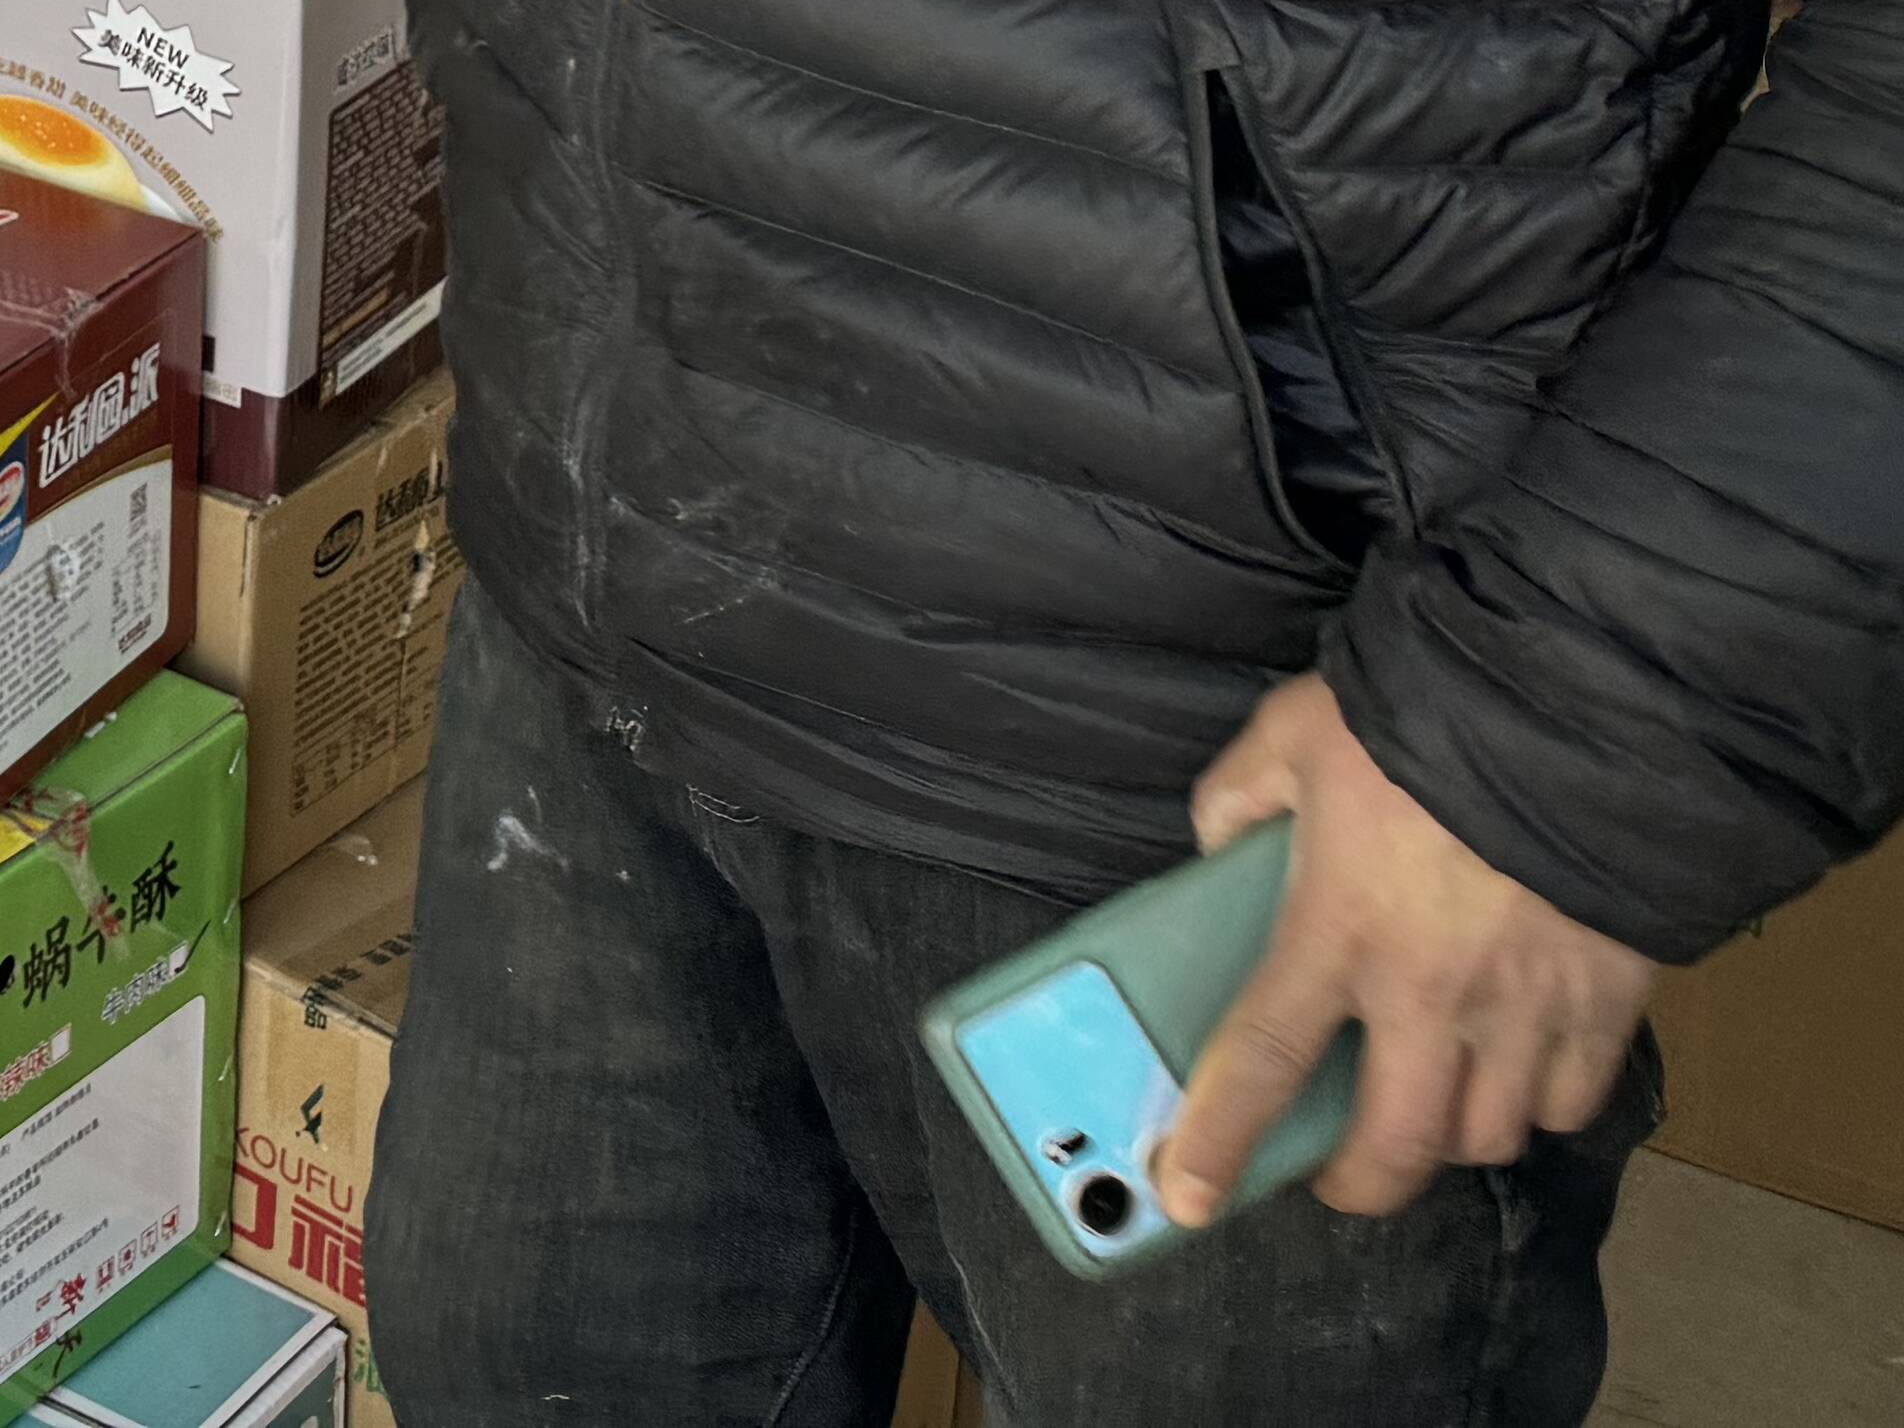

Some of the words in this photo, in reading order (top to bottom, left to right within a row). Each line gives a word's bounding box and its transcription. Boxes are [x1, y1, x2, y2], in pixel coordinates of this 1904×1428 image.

[99, 30, 210, 110] 美味新升级
[136, 27, 191, 70] NEW
